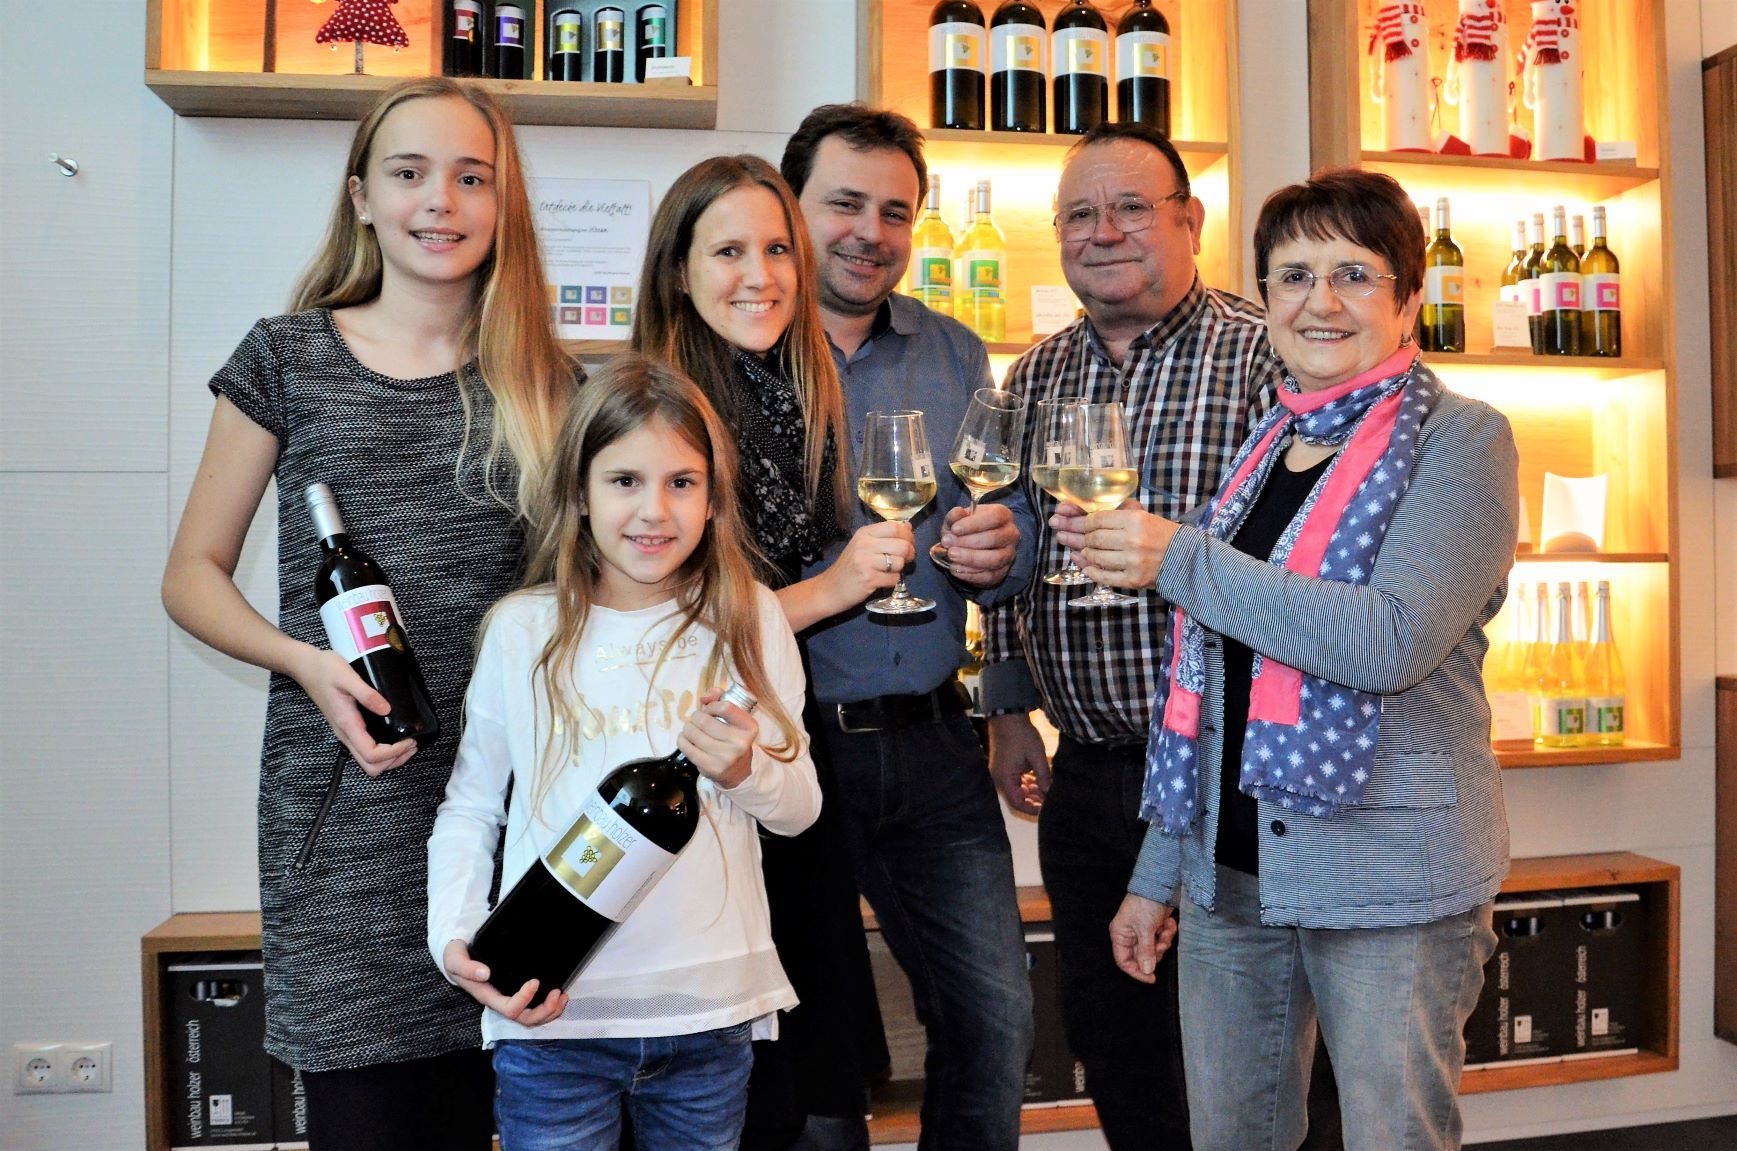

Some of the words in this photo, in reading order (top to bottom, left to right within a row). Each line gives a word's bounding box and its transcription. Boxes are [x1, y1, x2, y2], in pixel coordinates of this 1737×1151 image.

[185, 1019, 200, 1063] österreich
[187, 1071, 201, 1098] holzer
[188, 1101, 202, 1138] weinbau
[292, 1097, 307, 1135] weinbau
